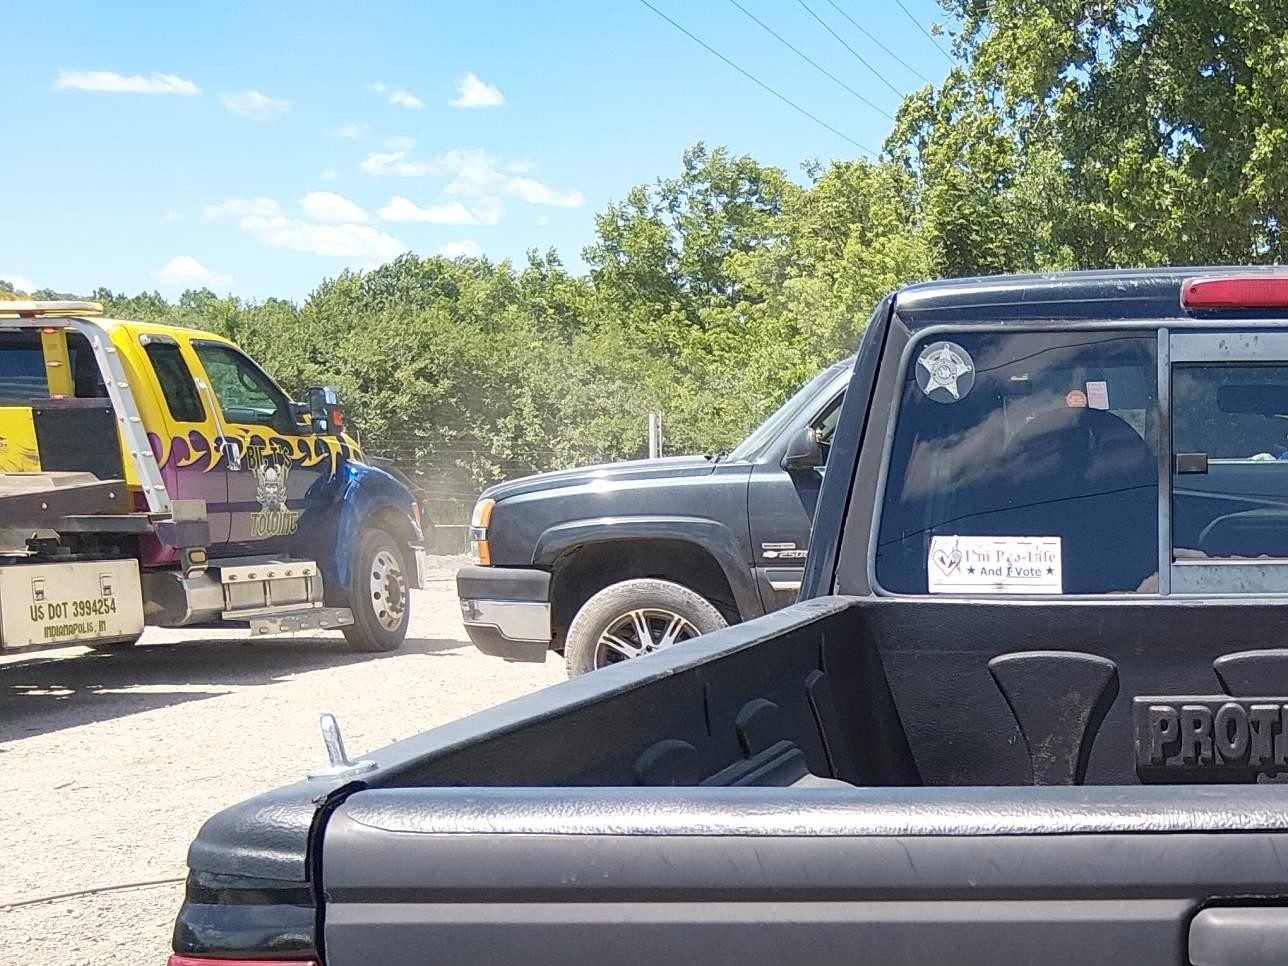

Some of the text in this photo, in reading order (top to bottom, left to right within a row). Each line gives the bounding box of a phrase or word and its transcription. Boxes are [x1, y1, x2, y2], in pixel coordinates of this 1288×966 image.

[249, 512, 298, 536] TOWING
[980, 567, 1002, 577] And
[1015, 566, 1042, 578] Vote
[30, 598, 117, 622] US DOT 3994254
[99, 620, 107, 632] IN
